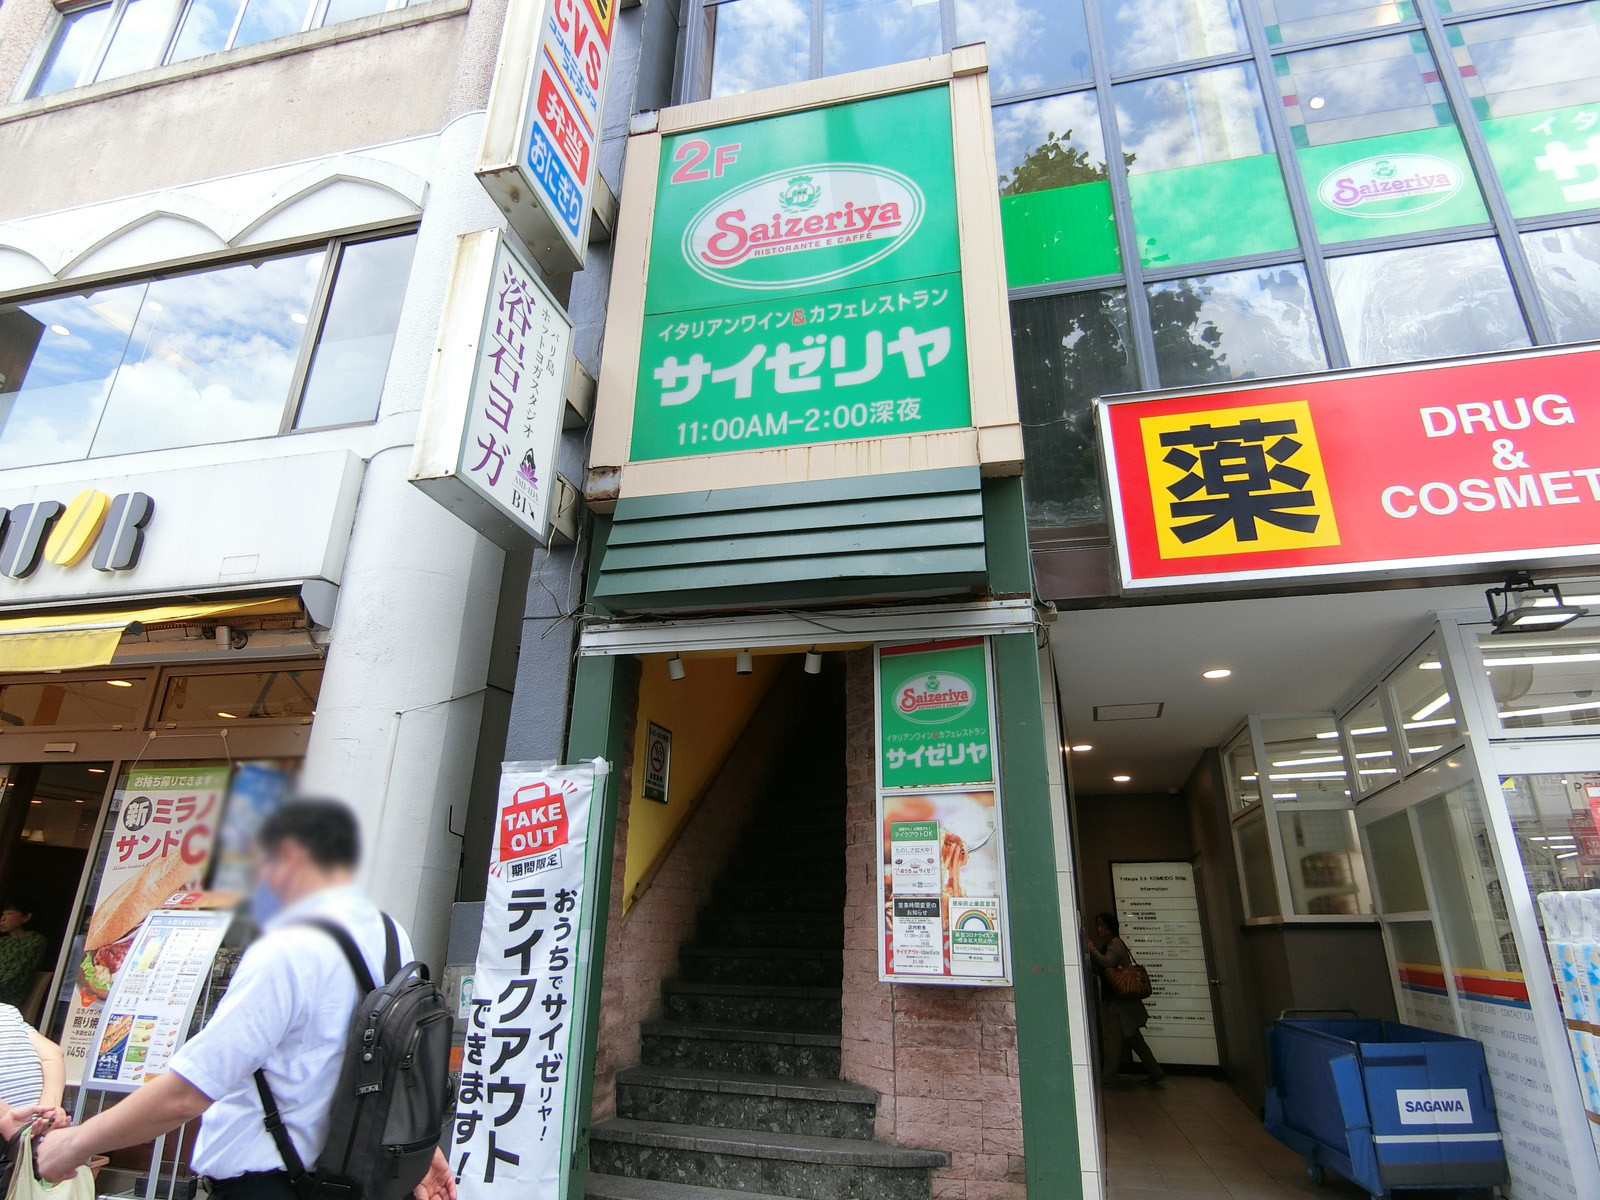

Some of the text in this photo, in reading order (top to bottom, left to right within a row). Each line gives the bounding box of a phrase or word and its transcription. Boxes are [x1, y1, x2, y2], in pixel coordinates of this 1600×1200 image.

[554, 0, 601, 90] CVS
[545, 92, 583, 174] 弁当
[531, 131, 582, 227] おにぎり
[670, 139, 741, 185] 2F
[1332, 173, 1451, 207] Saizeriya
[701, 201, 902, 268] Saizeriya
[754, 240, 820, 257] RISTORANTE
[523, 308, 550, 438] ホットヨガスタジオ
[653, 325, 951, 407] サイゼリヤ
[1419, 393, 1576, 439] DRUG
[1492, 438, 1528, 471] &
[1158, 418, 1321, 544] 薬
[0, 488, 154, 580] TOR
[900, 688, 969, 712] Saizeriya
[886, 742, 988, 769] サイゼリヤ
[125, 794, 216, 828] 新 ミラノ
[504, 802, 563, 830] TAKE
[511, 827, 557, 851] OUT
[511, 852, 558, 878] 期間限定
[483, 889, 547, 1183] テイクアウト
[535, 888, 576, 1142] おうちでサイゼリヤ!
[455, 998, 493, 1185] できます!
[1404, 1099, 1464, 1113] SAGAWA
